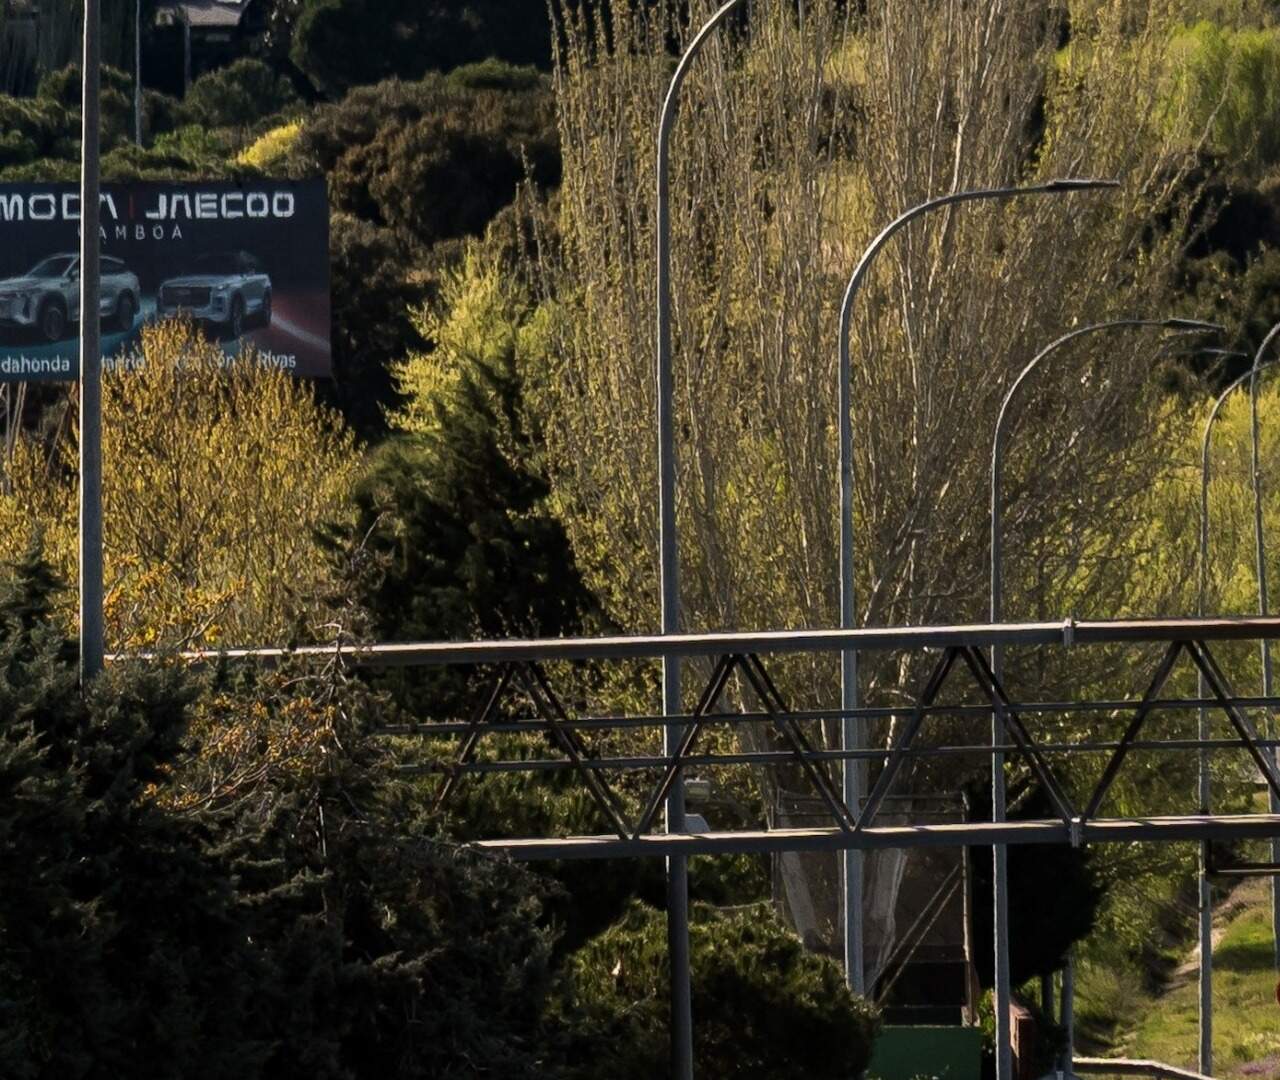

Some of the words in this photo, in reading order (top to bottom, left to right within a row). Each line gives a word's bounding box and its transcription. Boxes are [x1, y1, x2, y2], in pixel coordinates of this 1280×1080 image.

[145, 192, 295, 219] JAECOO
[77, 224, 182, 240] AMBOA
[1, 354, 71, 374] dahonda
